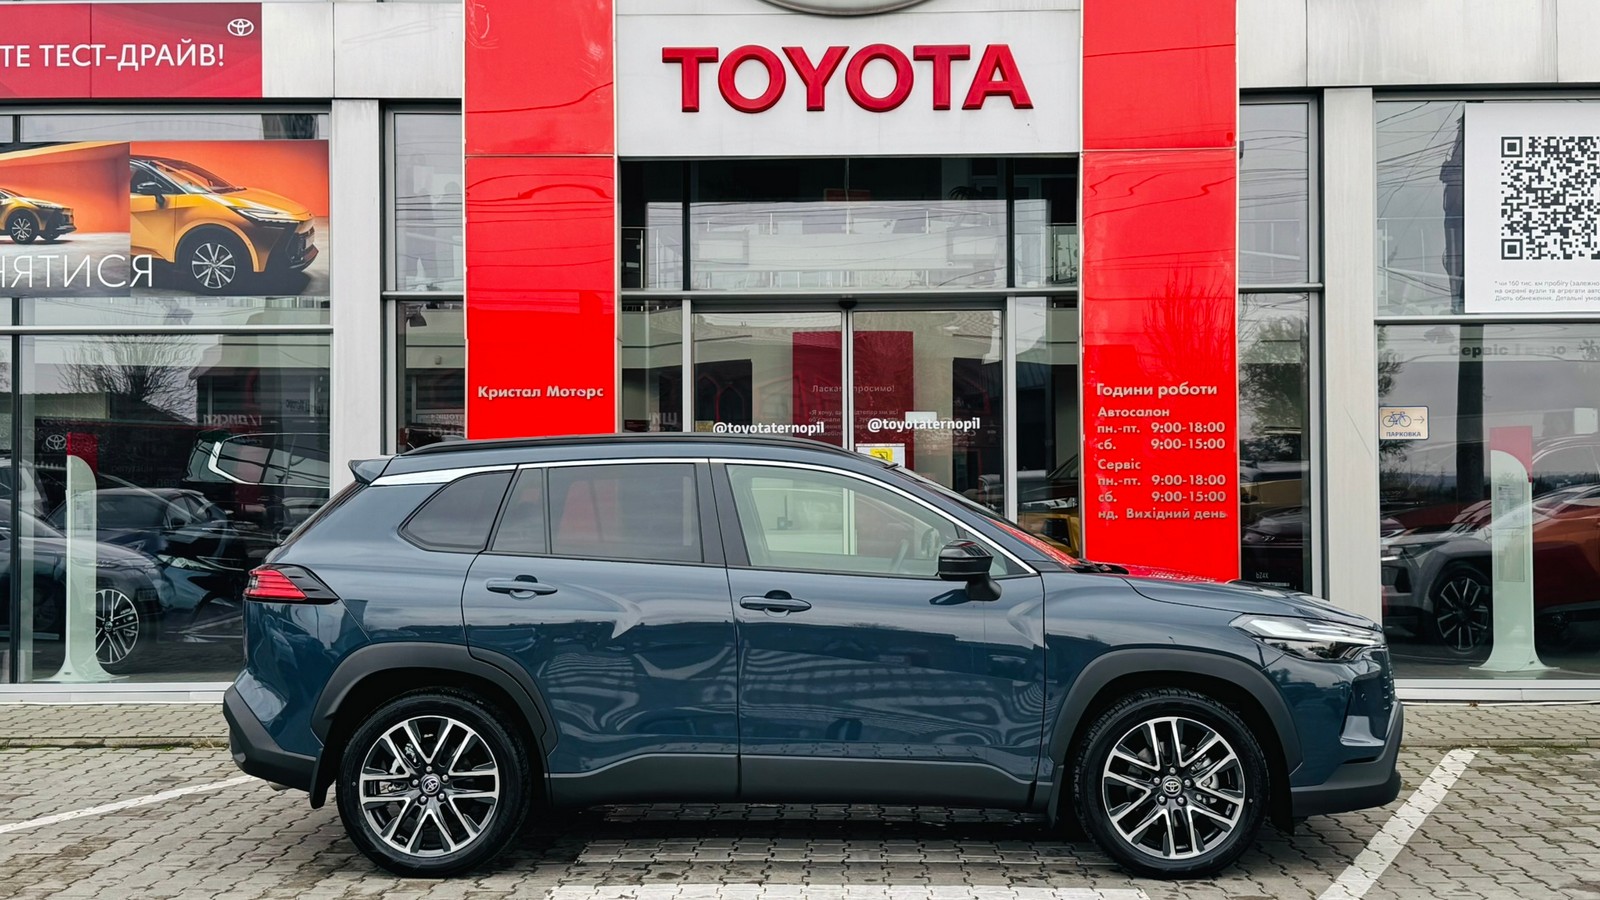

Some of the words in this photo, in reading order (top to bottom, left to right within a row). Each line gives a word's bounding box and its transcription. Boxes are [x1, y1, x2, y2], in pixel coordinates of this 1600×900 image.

[0, 45, 31, 67] ТЕ
[39, 38, 225, 71] ТЕСТ-ДРАЙВ!
[662, 43, 1034, 113] TOYOTA
[0, 254, 153, 288] ЯТИСЯ
[477, 386, 541, 400] Кристал
[546, 385, 603, 399] Моторс
[1096, 382, 1153, 397] Години
[1158, 381, 1217, 399] роботи
[1097, 406, 1170, 417] Автосалон
[712, 421, 825, 436] @toyotaternopil
[867, 417, 980, 432] @toyotaternopil
[1097, 425, 1140, 433] пн.-пт.
[1150, 421, 1226, 433] 9:00-18:00
[1097, 438, 1117, 450] сб.
[1150, 438, 1226, 450] 9:00-15:00
[1097, 458, 1141, 472] Сервіс
[1097, 477, 1141, 486] пн.-пт.
[1151, 474, 1226, 486] 9:00-18:00
[1098, 491, 1117, 502] сб.
[1151, 491, 1227, 502] 9:00-15:00
[1098, 510, 1118, 520] нд.
[1126, 507, 1190, 520] Вихідний
[1194, 509, 1227, 520] день
